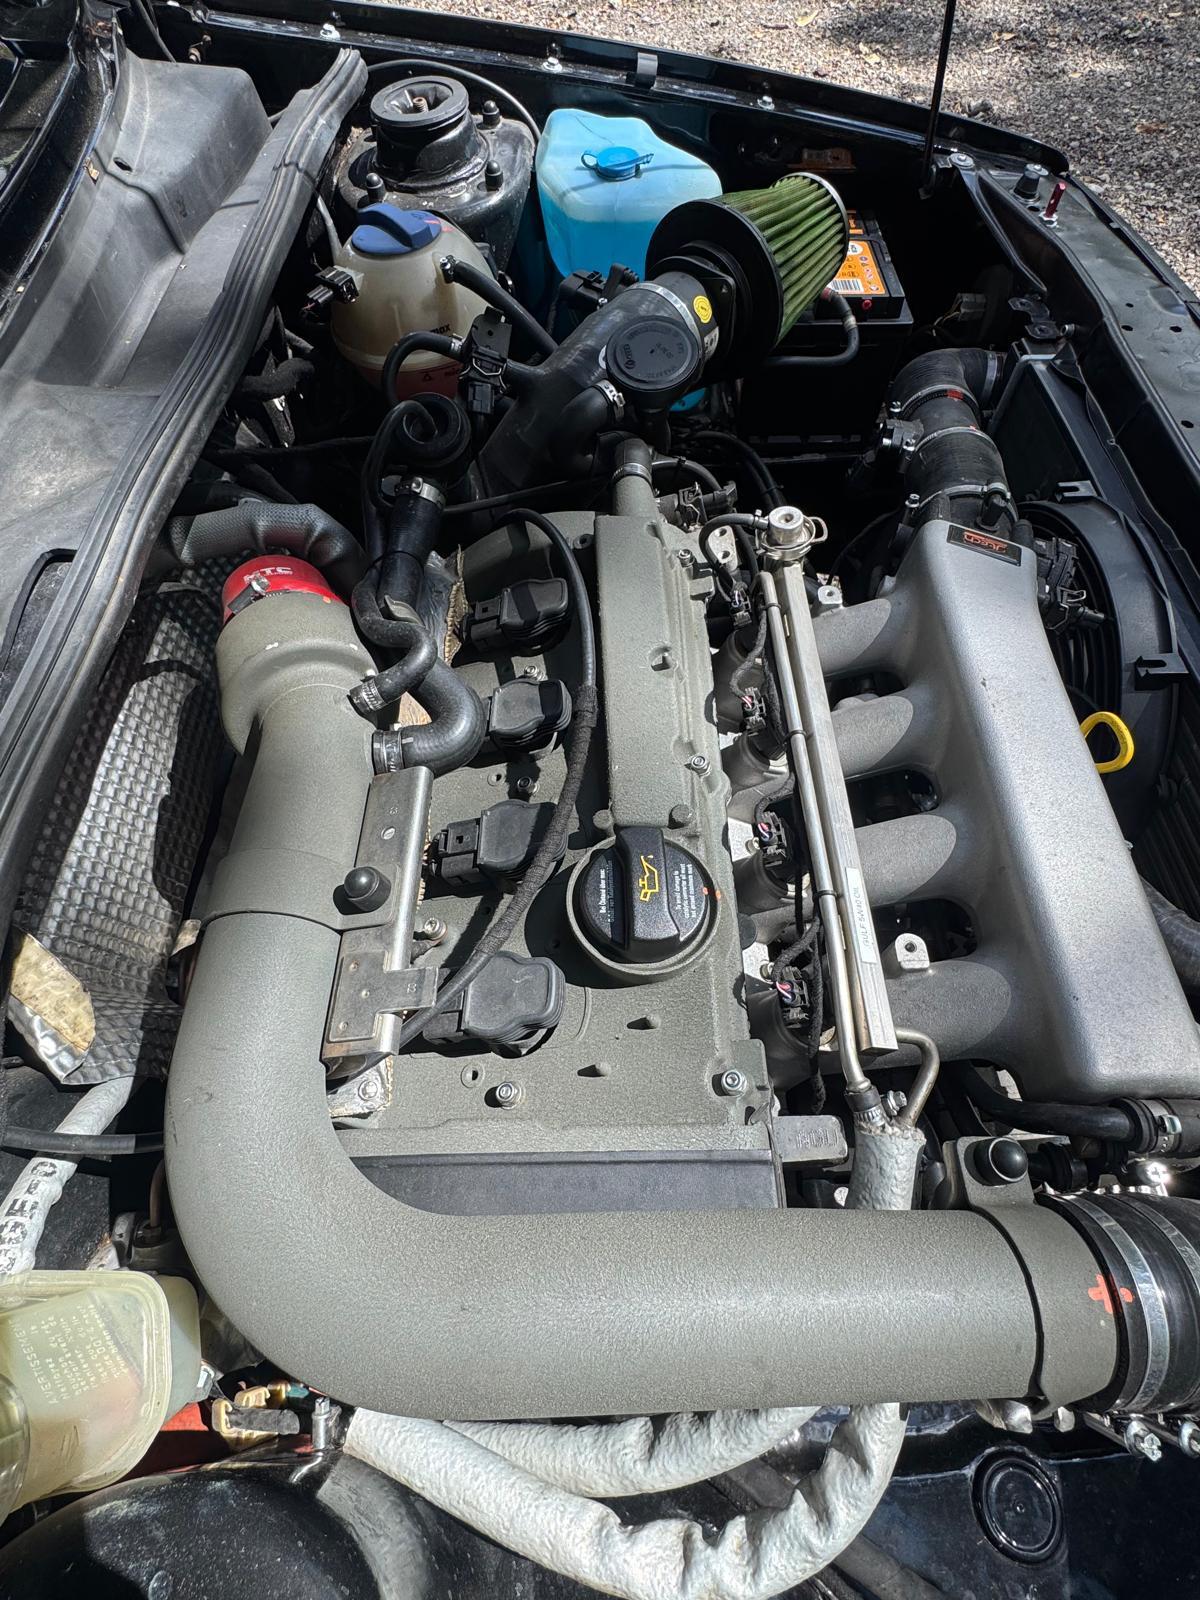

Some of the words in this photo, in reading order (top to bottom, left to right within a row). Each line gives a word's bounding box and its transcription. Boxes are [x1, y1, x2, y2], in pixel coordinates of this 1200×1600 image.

[673, 876, 681, 891] damage
[682, 900, 690, 918] catalytic
[860, 923, 870, 947] GULF
